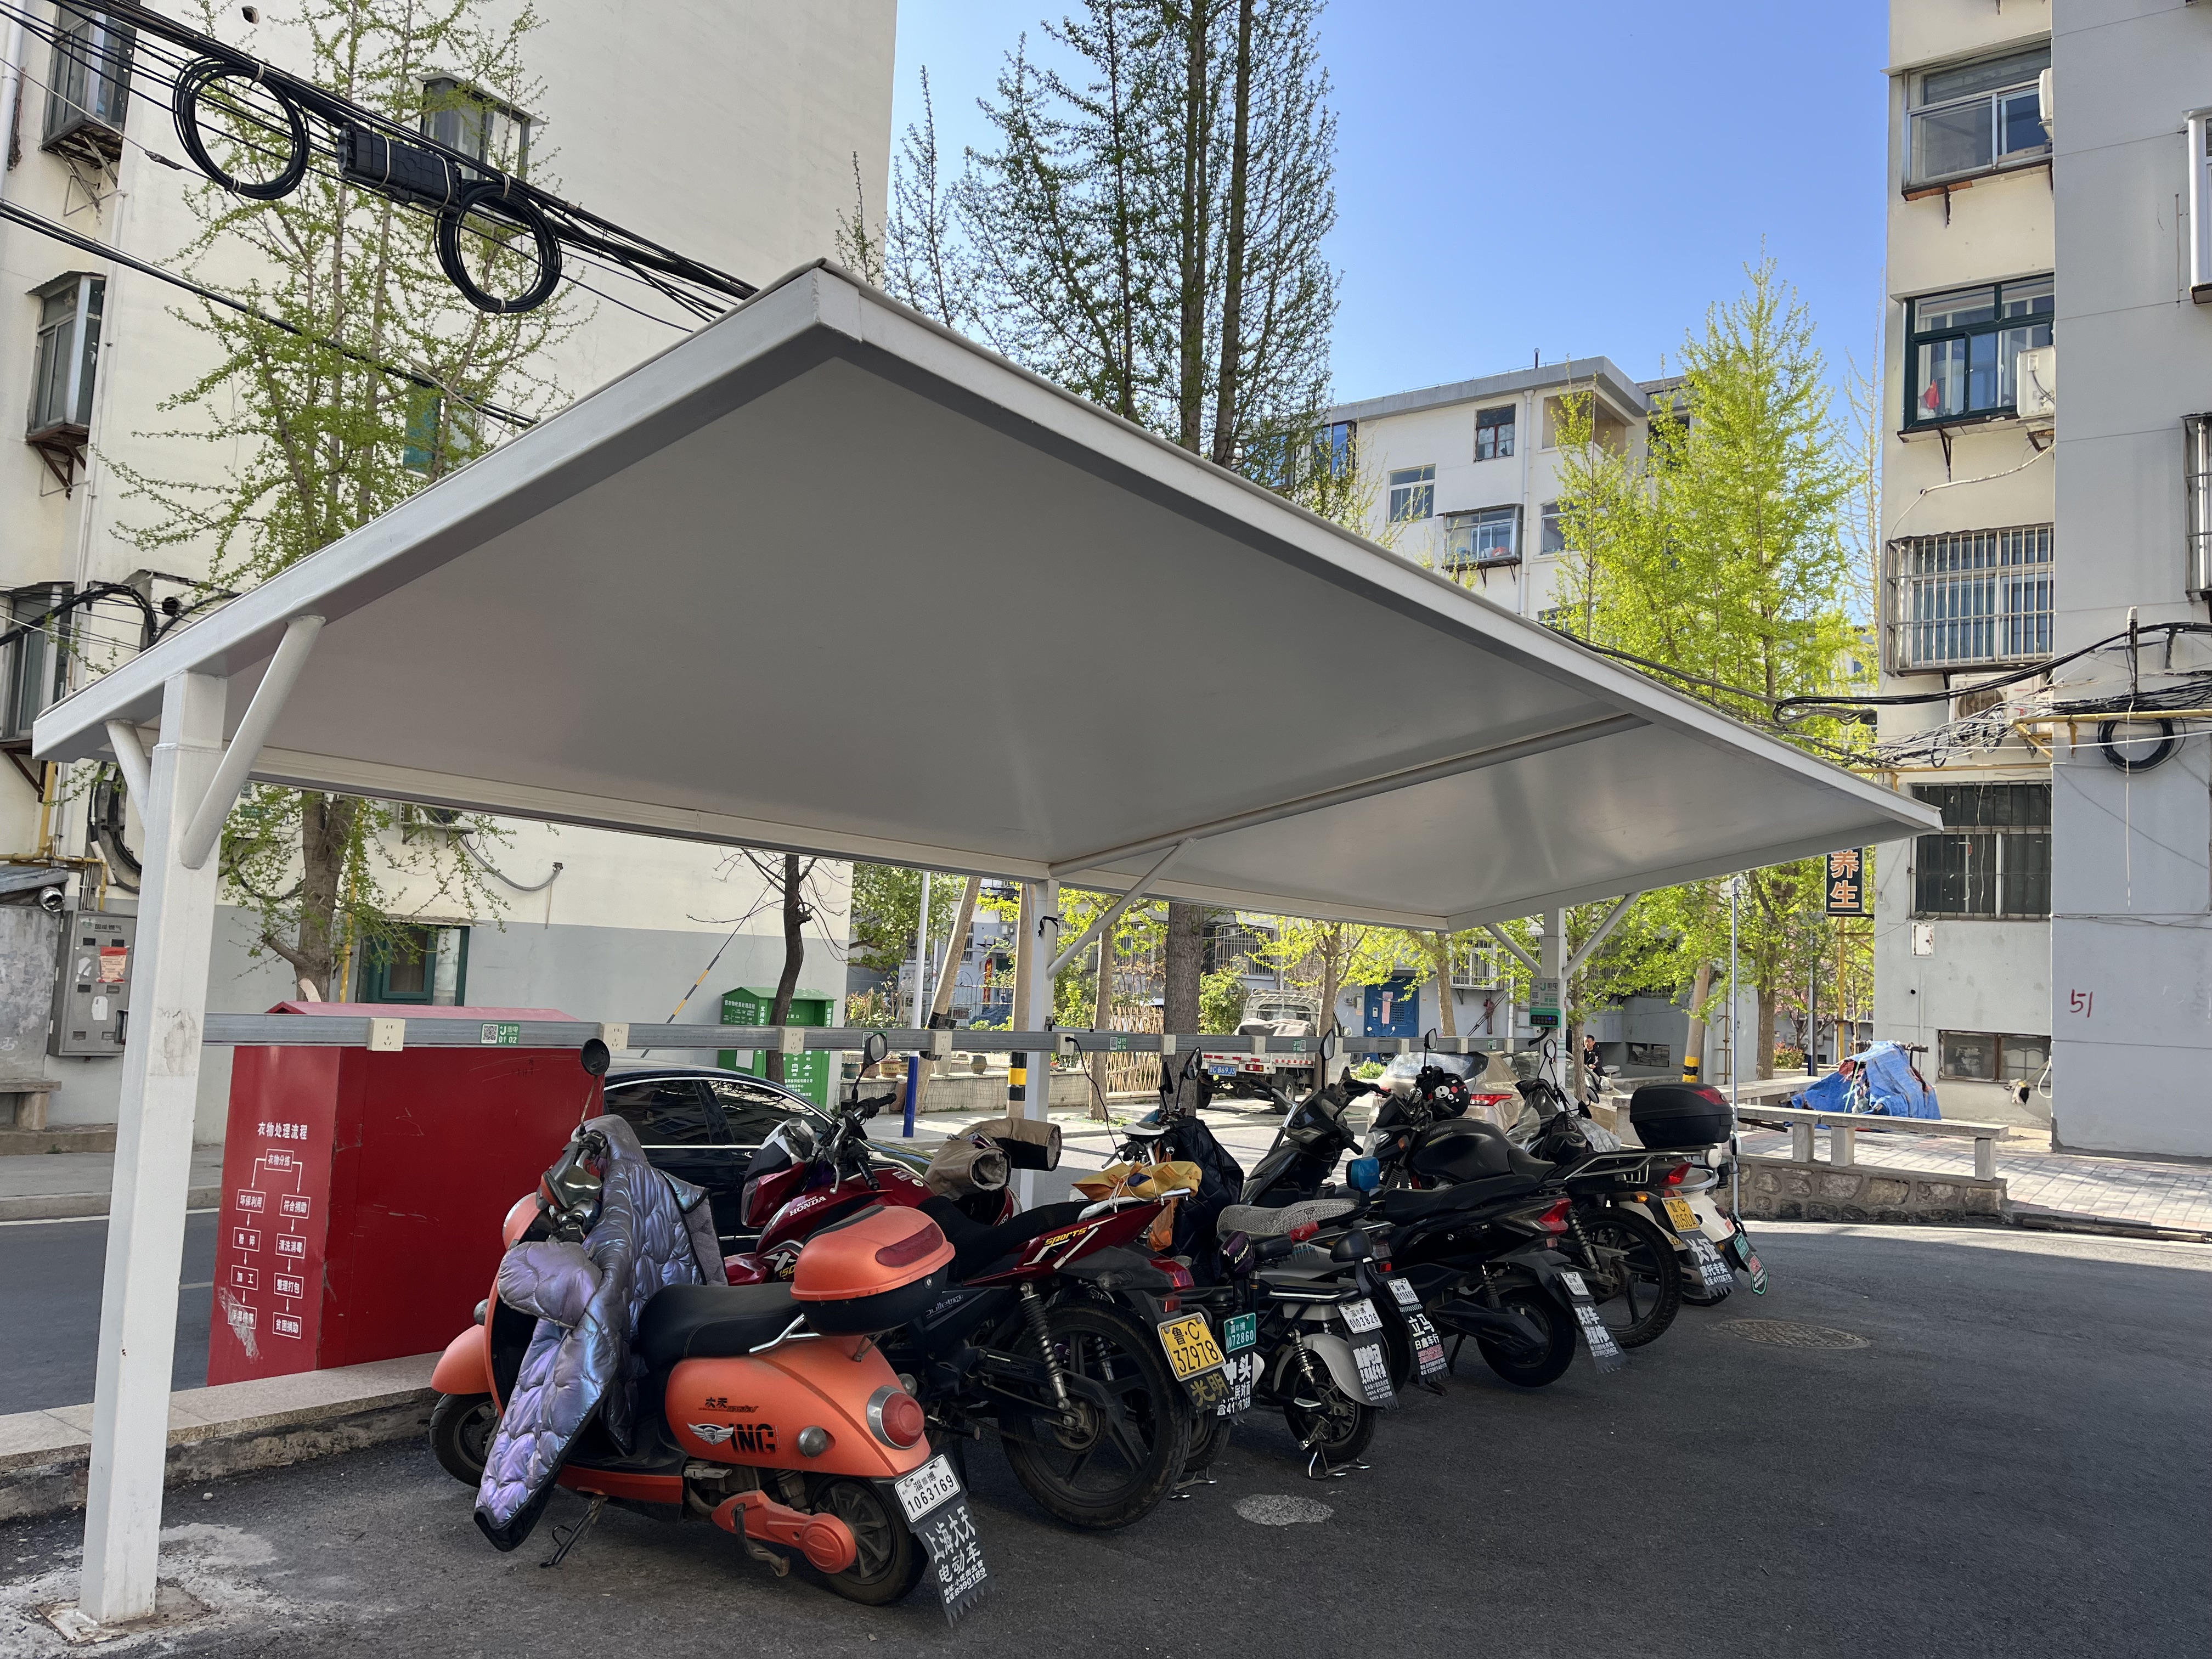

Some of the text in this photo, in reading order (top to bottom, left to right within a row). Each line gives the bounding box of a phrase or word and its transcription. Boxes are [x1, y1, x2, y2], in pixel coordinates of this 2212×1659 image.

[1830, 850, 1859, 908] 养生
[2069, 989, 2093, 1018] 51
[257, 1121, 308, 1140] 衣物处理流程
[239, 1194, 263, 1208] 环保利用
[283, 1200, 308, 1214] 符合捐助
[789, 1196, 827, 1216] HONDA
[278, 1239, 302, 1254] 清洗消毒
[1686, 1238, 1721, 1265] 长征
[276, 1279, 300, 1294] 整理打包
[275, 1318, 299, 1334] 贫困捐助
[1408, 1313, 1435, 1338] 立马
[1189, 1372, 1229, 1407] 光明
[704, 1397, 728, 1409] 大天
[913, 1471, 936, 1493] 淄博
[907, 1475, 954, 1513] 1063169
[924, 1505, 976, 1565] 上海大天
[938, 1541, 981, 1583] 电动车
